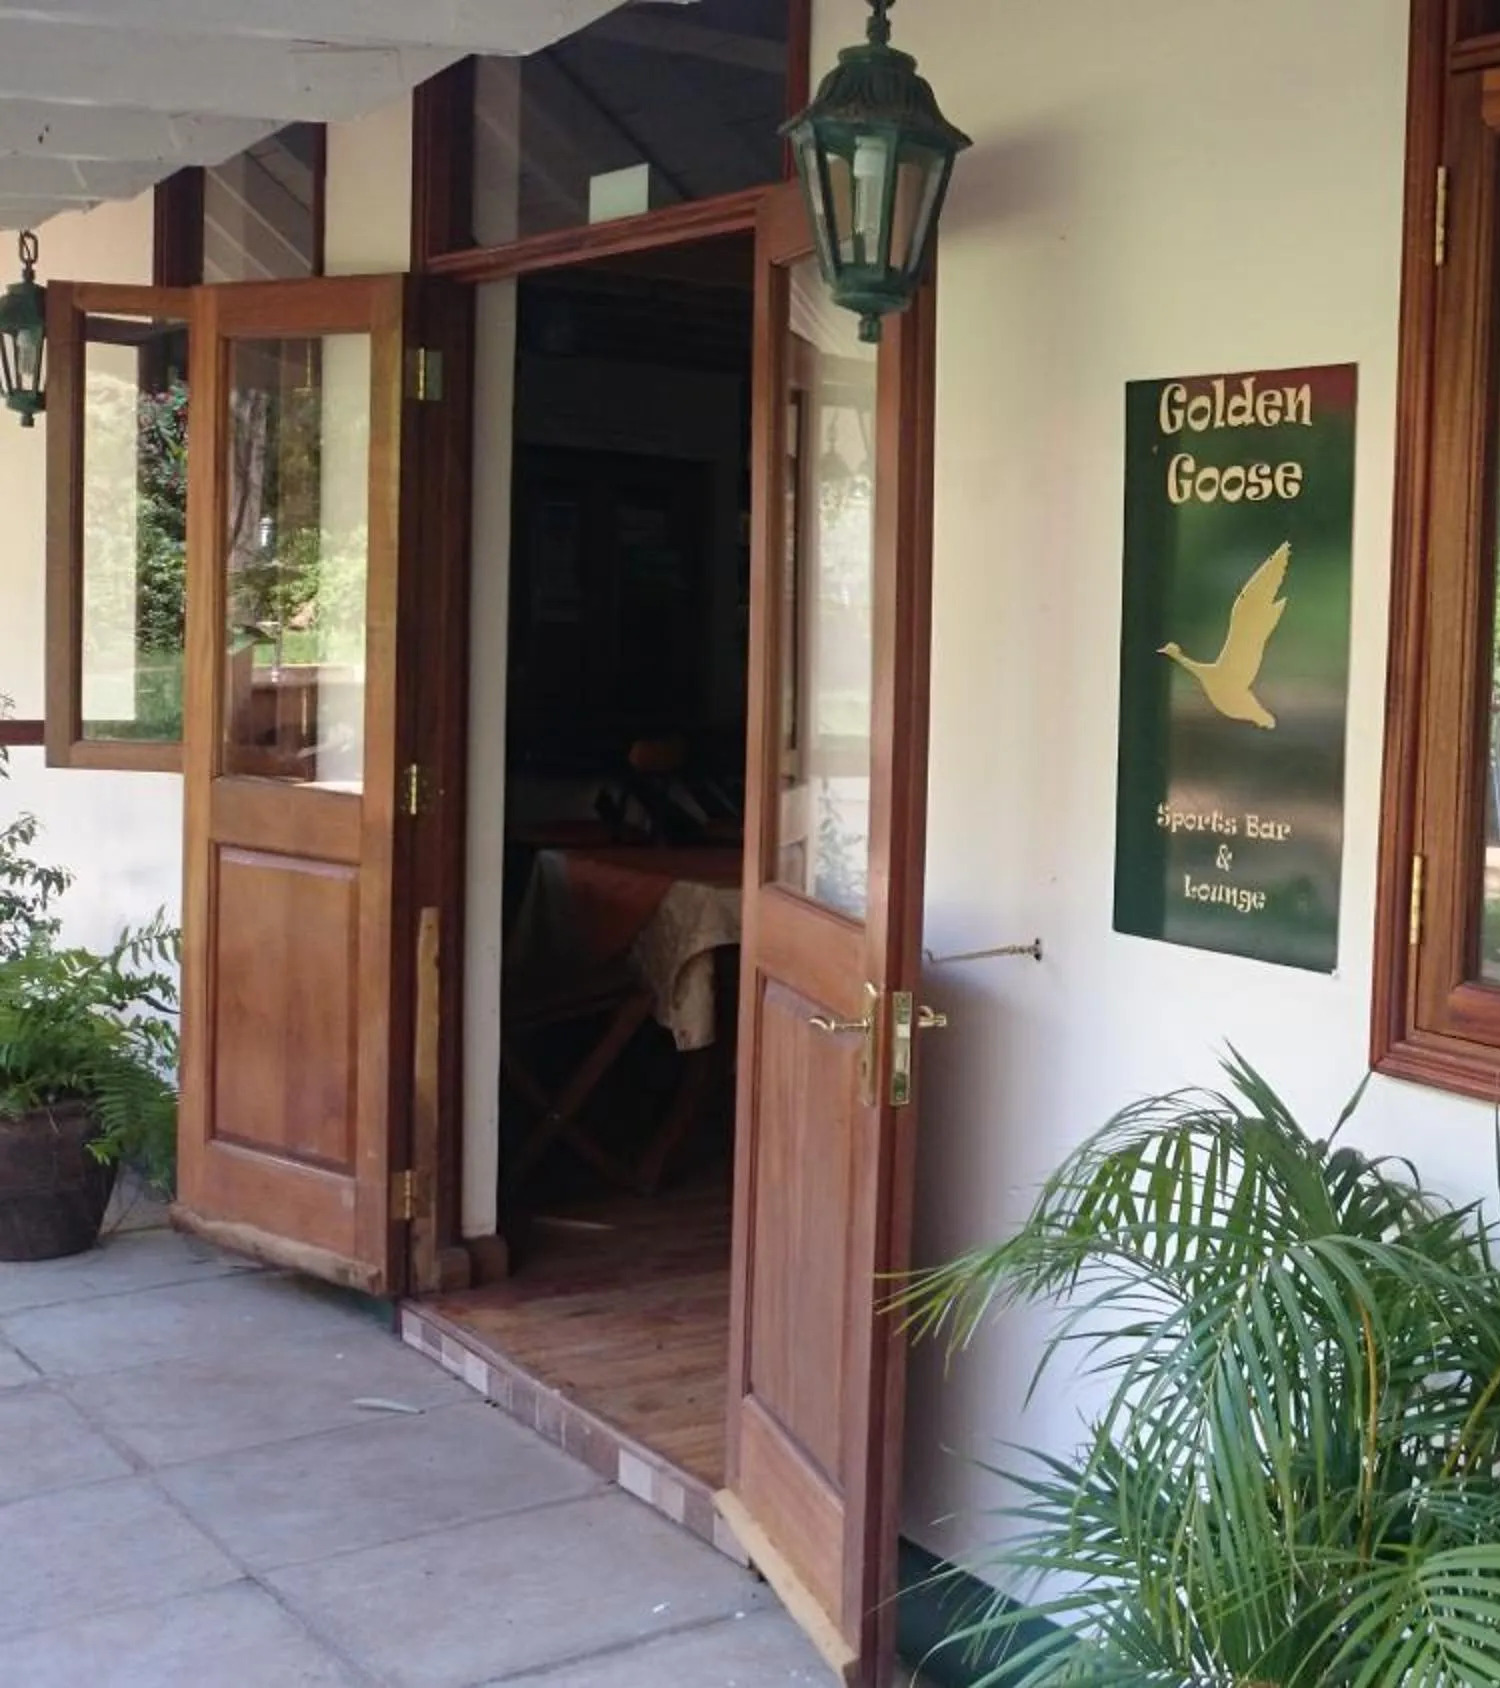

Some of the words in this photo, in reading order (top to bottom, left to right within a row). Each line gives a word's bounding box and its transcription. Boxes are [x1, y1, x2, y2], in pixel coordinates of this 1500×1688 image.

[1159, 377, 1313, 434] Golden
[1167, 453, 1304, 504] Goose
[1157, 802, 1238, 835] Sports
[1246, 813, 1291, 841] Bar
[1216, 844, 1233, 872] &
[1184, 874, 1267, 914] Lounge
